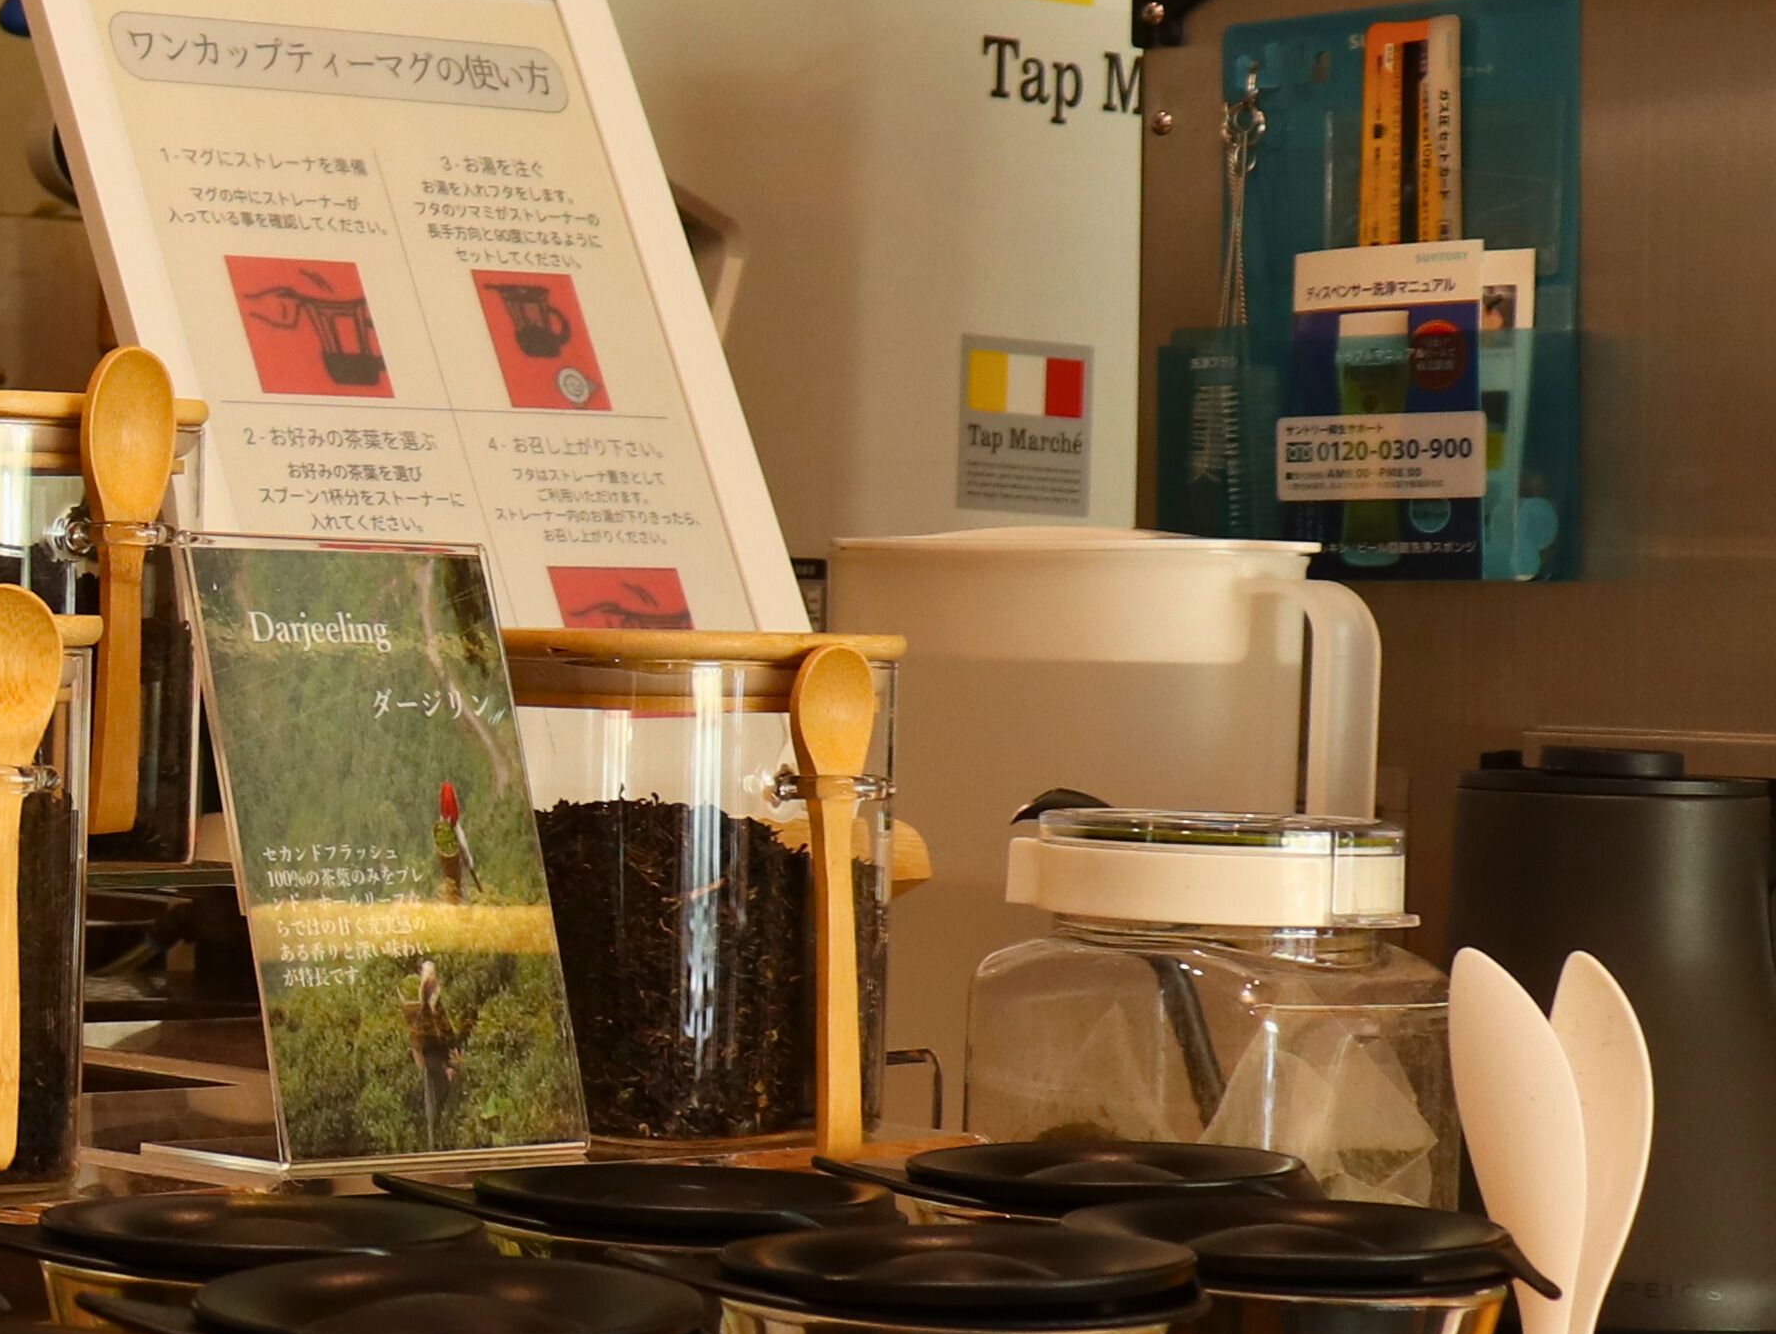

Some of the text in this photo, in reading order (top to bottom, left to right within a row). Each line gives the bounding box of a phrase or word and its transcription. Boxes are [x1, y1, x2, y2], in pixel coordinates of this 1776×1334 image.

[124, 27, 552, 99] ワンカップティーマグの使い方
[982, 34, 1083, 125] Tap
[967, 422, 1083, 455] Tap Marché
[1316, 436, 1473, 463] 0120-030-900
[247, 610, 393, 653] Darjeeling
[370, 687, 490, 721] ダージリン
[262, 843, 399, 864] セカンドフラッシュ
